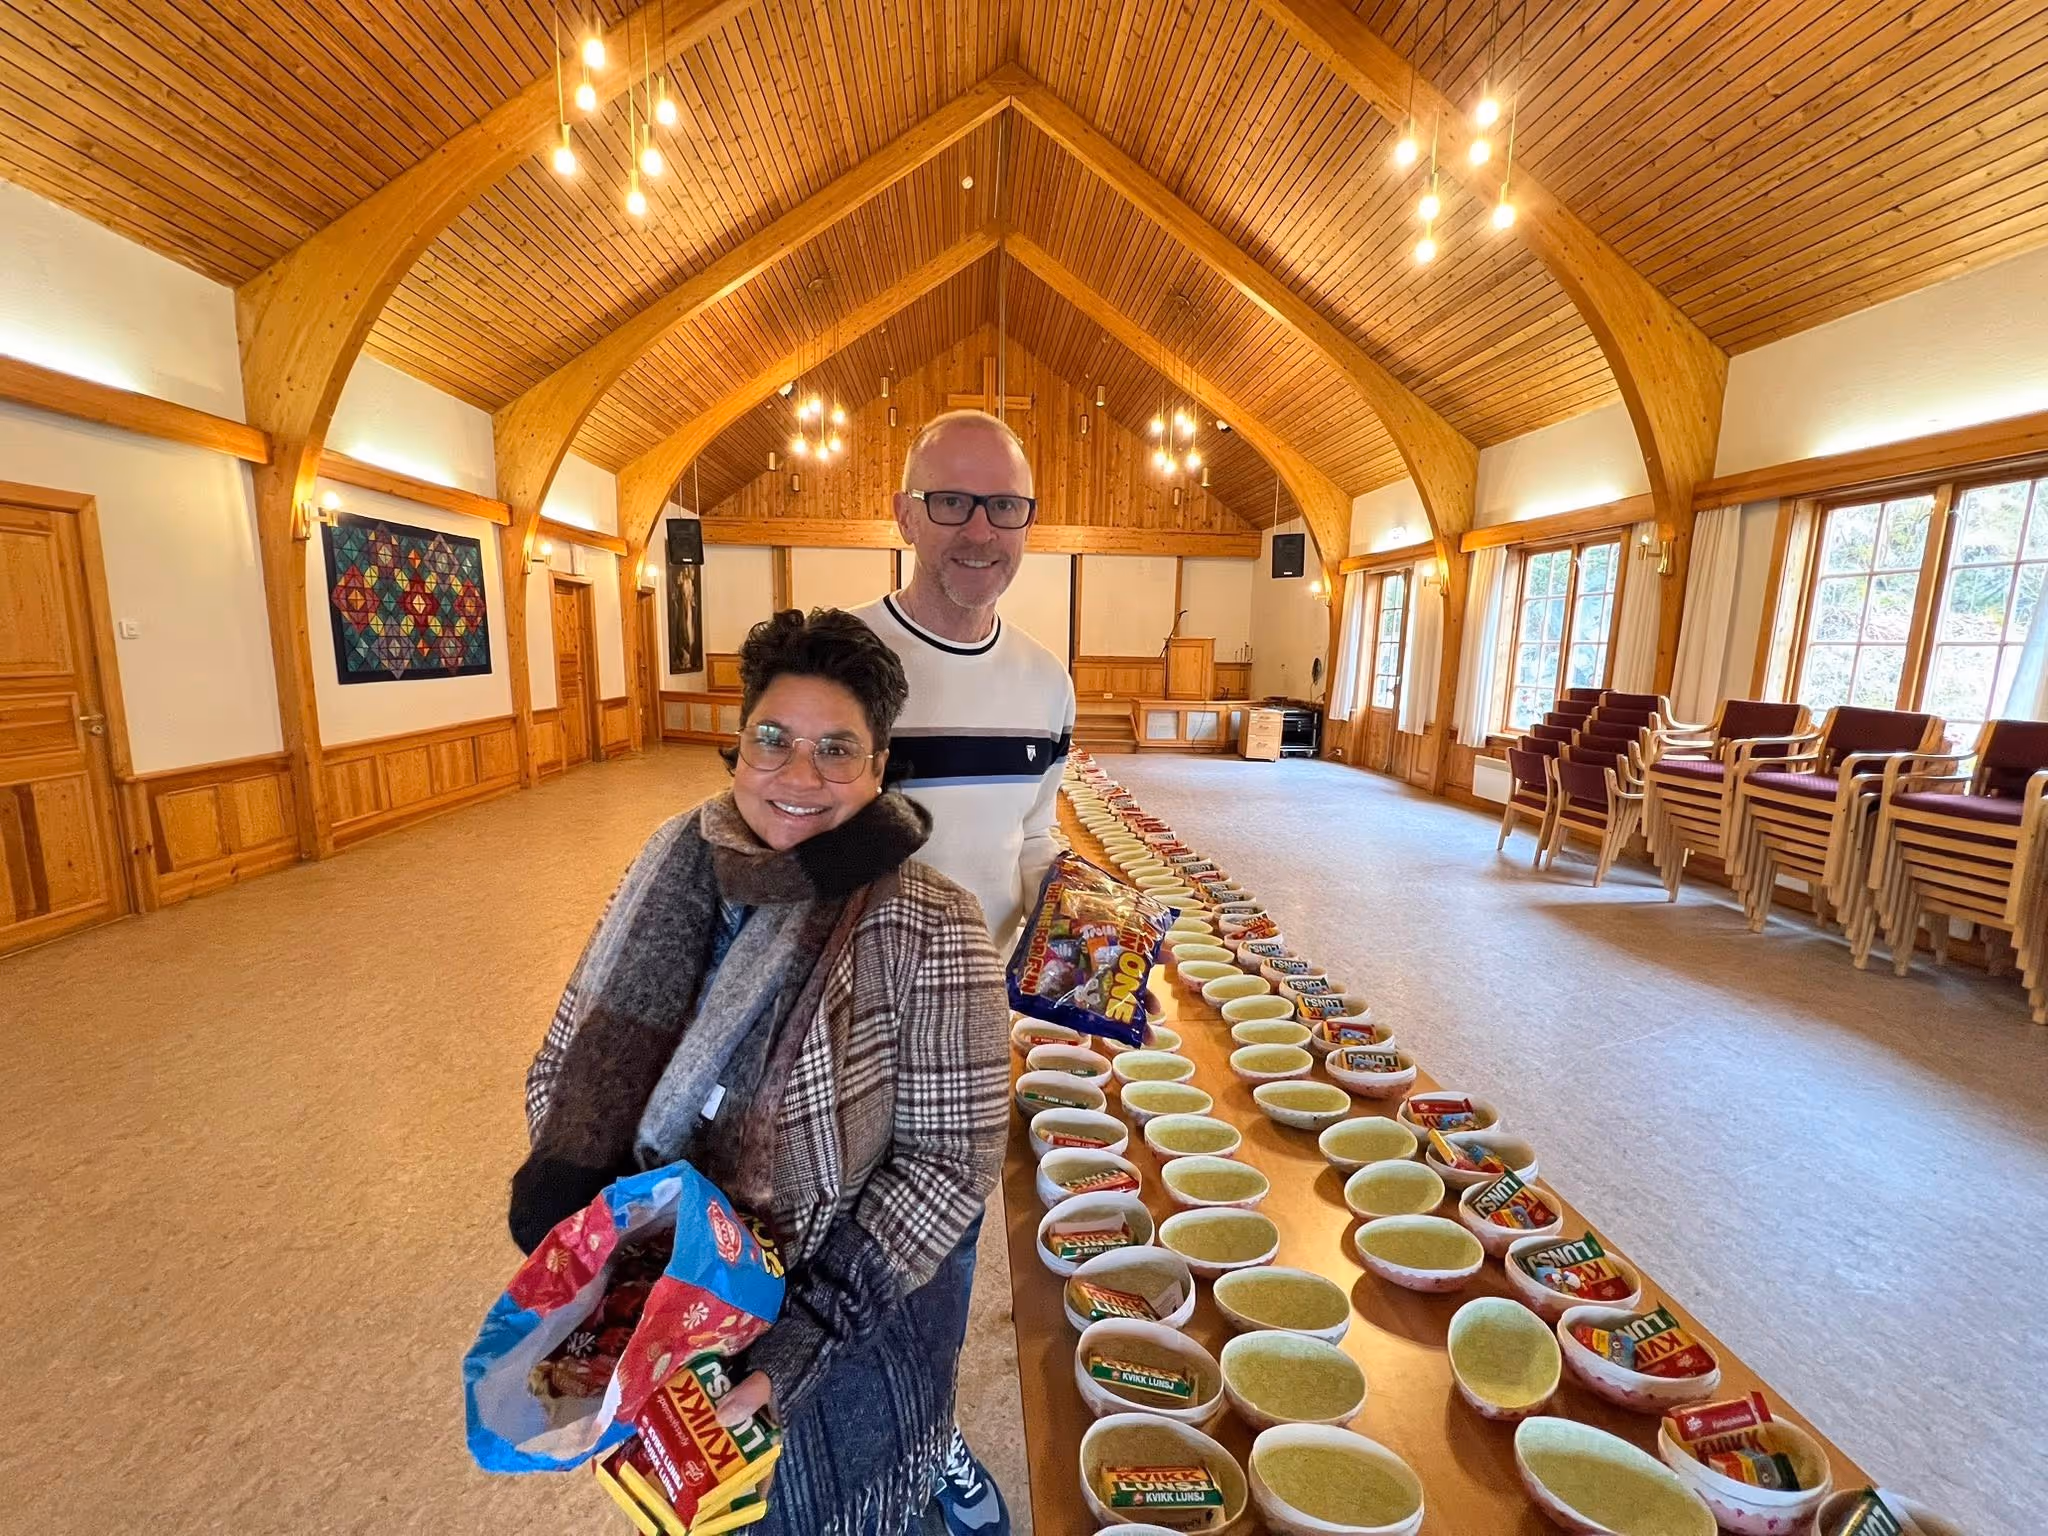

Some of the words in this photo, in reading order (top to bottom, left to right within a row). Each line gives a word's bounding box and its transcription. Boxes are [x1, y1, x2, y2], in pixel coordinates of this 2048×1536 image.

[1044, 882, 1063, 902] THE
[1037, 903, 1055, 928] ONE
[1029, 928, 1049, 957] FOR
[1019, 957, 1044, 996] FUN
[1105, 951, 1146, 1024] ONE
[1475, 1176, 1518, 1218] LUNSJ
[1527, 1240, 1593, 1273] LUNSJ
[1122, 1371, 1147, 1384] KVIKK
[1148, 1377, 1175, 1390] LUNSJ
[672, 1375, 739, 1471] KVIKK
[696, 1361, 766, 1454] LUSJ
[643, 1434, 661, 1467] KVIKK
[647, 1421, 666, 1455] KVIKK
[662, 1453, 685, 1491] LUNSJ
[1117, 1472, 1200, 1482] KVIKK
[1119, 1482, 1214, 1491] LUNSJ
[1146, 1491, 1174, 1503] KVIKK
[1175, 1491, 1205, 1502] LUNSJ
